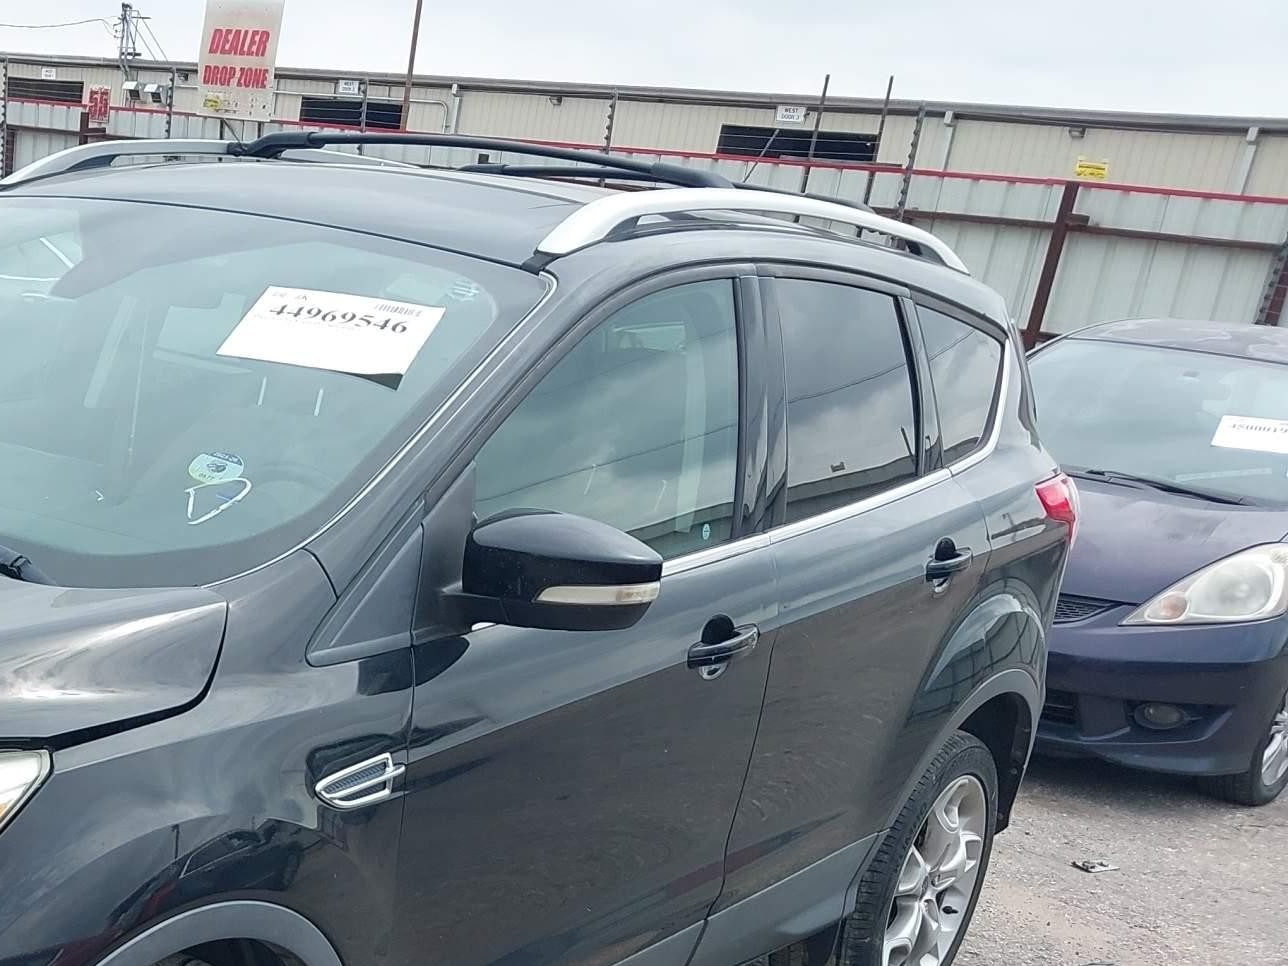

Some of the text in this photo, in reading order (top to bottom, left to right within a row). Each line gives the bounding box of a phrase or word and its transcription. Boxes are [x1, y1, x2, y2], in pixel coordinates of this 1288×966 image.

[208, 28, 270, 57] DEALER
[202, 65, 269, 89] DROP ZONE
[269, 303, 408, 334] 44969546
